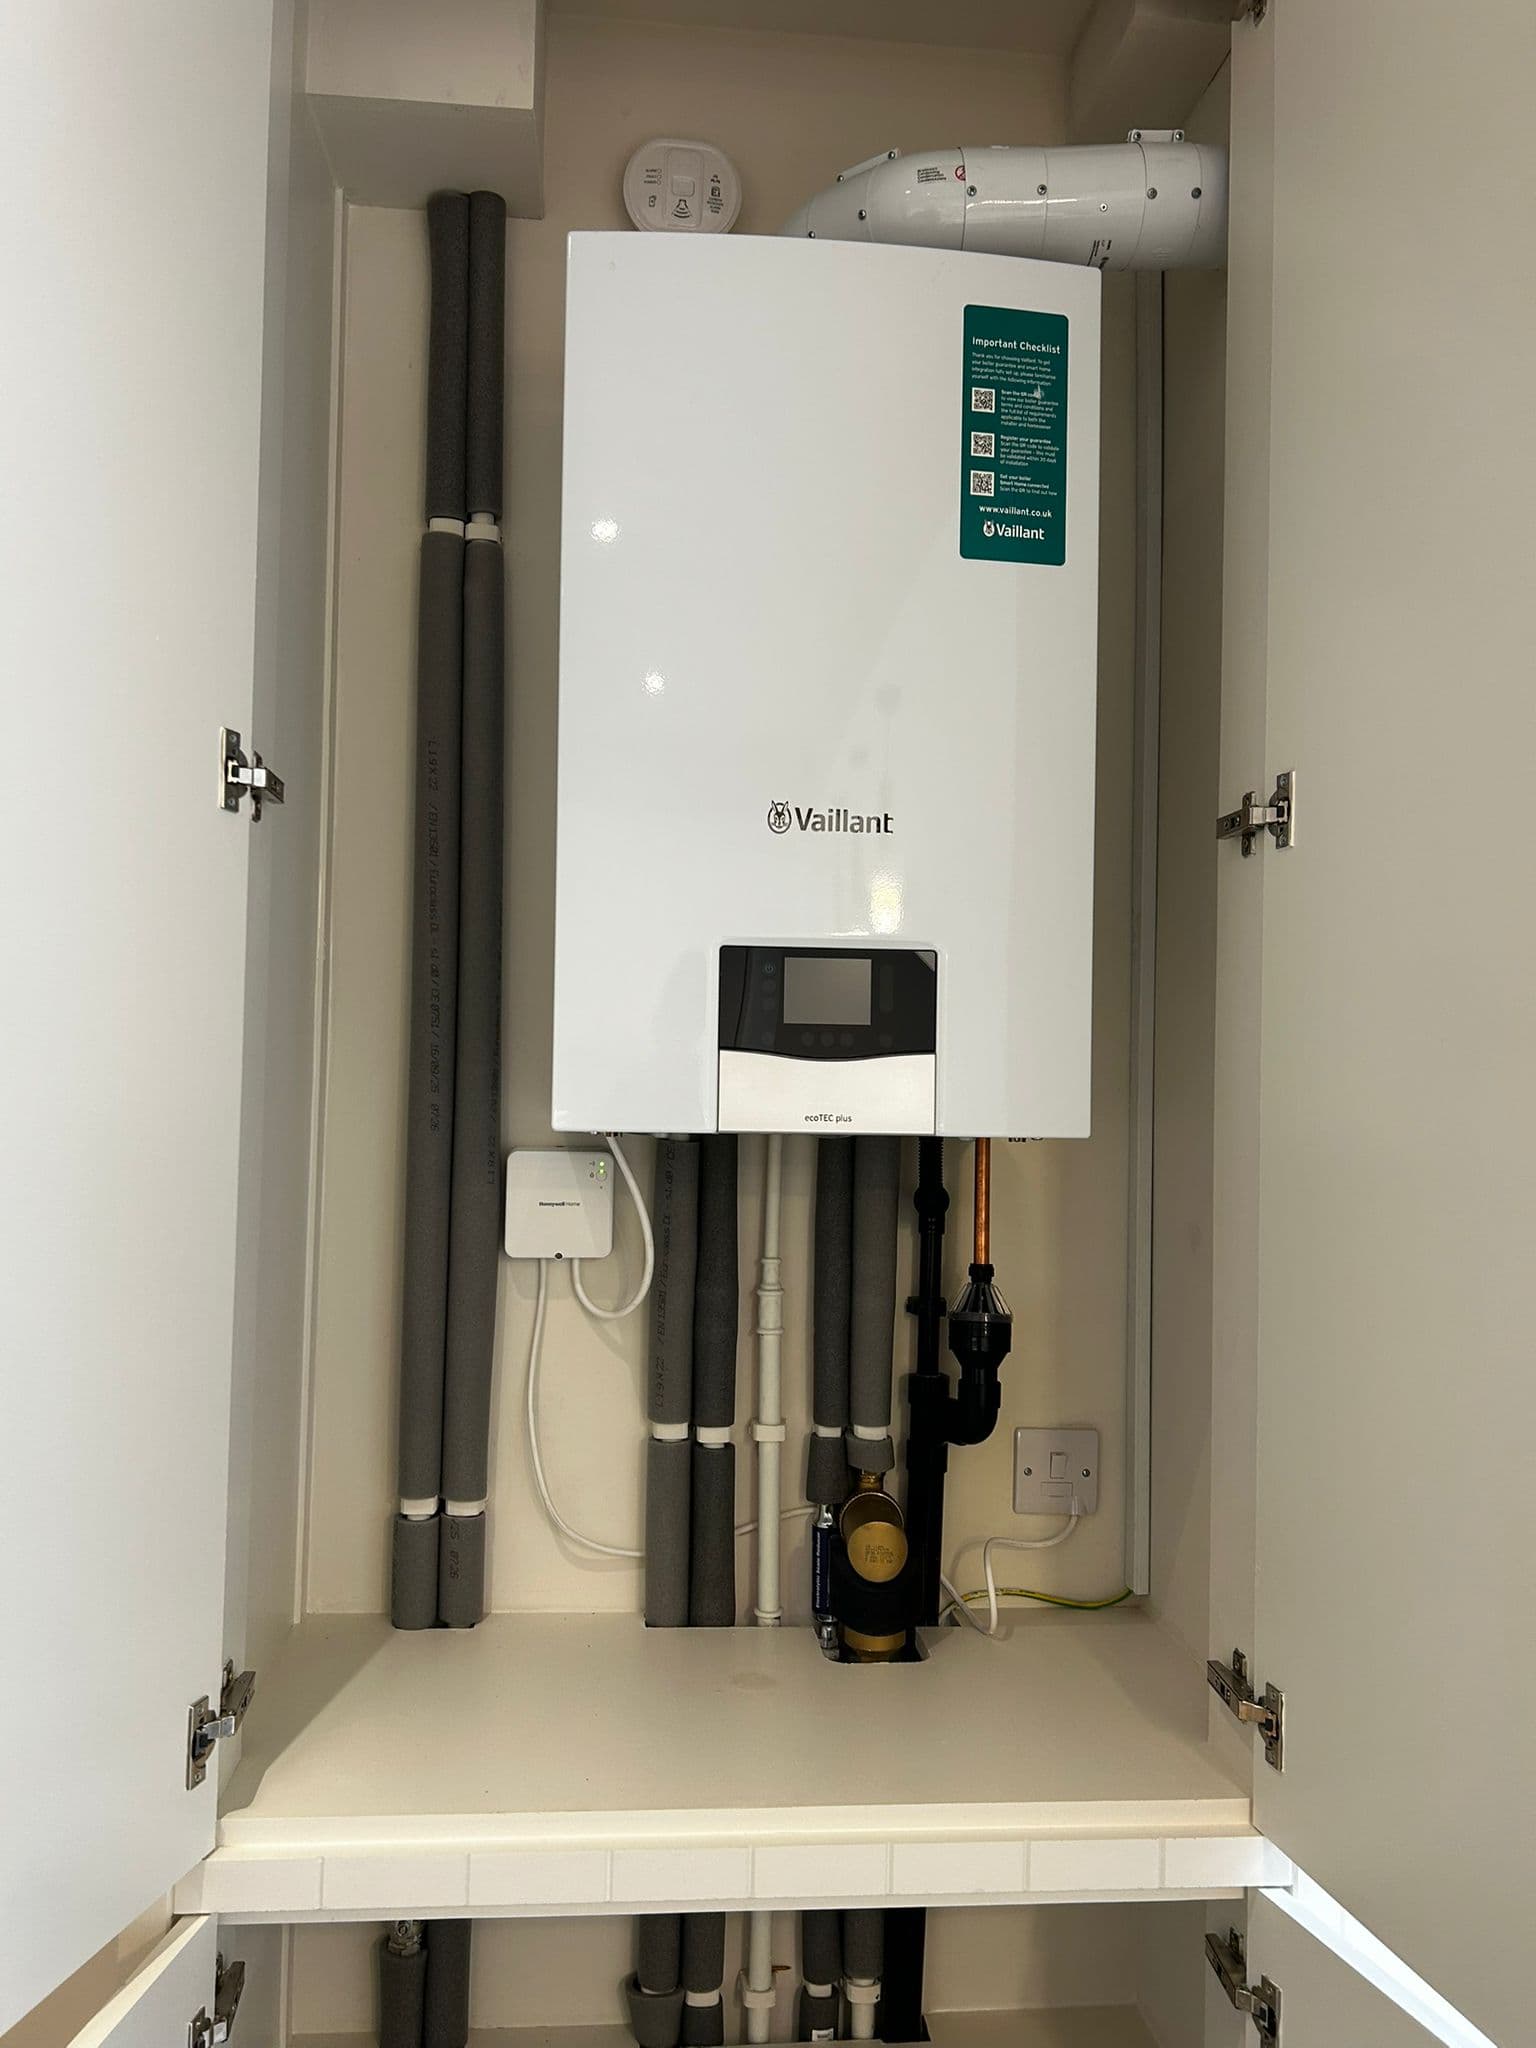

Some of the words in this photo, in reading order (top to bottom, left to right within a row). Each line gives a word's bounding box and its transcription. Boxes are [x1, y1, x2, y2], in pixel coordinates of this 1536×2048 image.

[973, 336, 1017, 350] Important
[1020, 341, 1060, 354] Checklist
[979, 506, 1052, 518] www.vaillant.co.uk
[996, 523, 1045, 540] Vaillant
[795, 807, 894, 834] Vaillant
[804, 1114, 834, 1122] ecoTEC
[836, 1113, 852, 1124] plus
